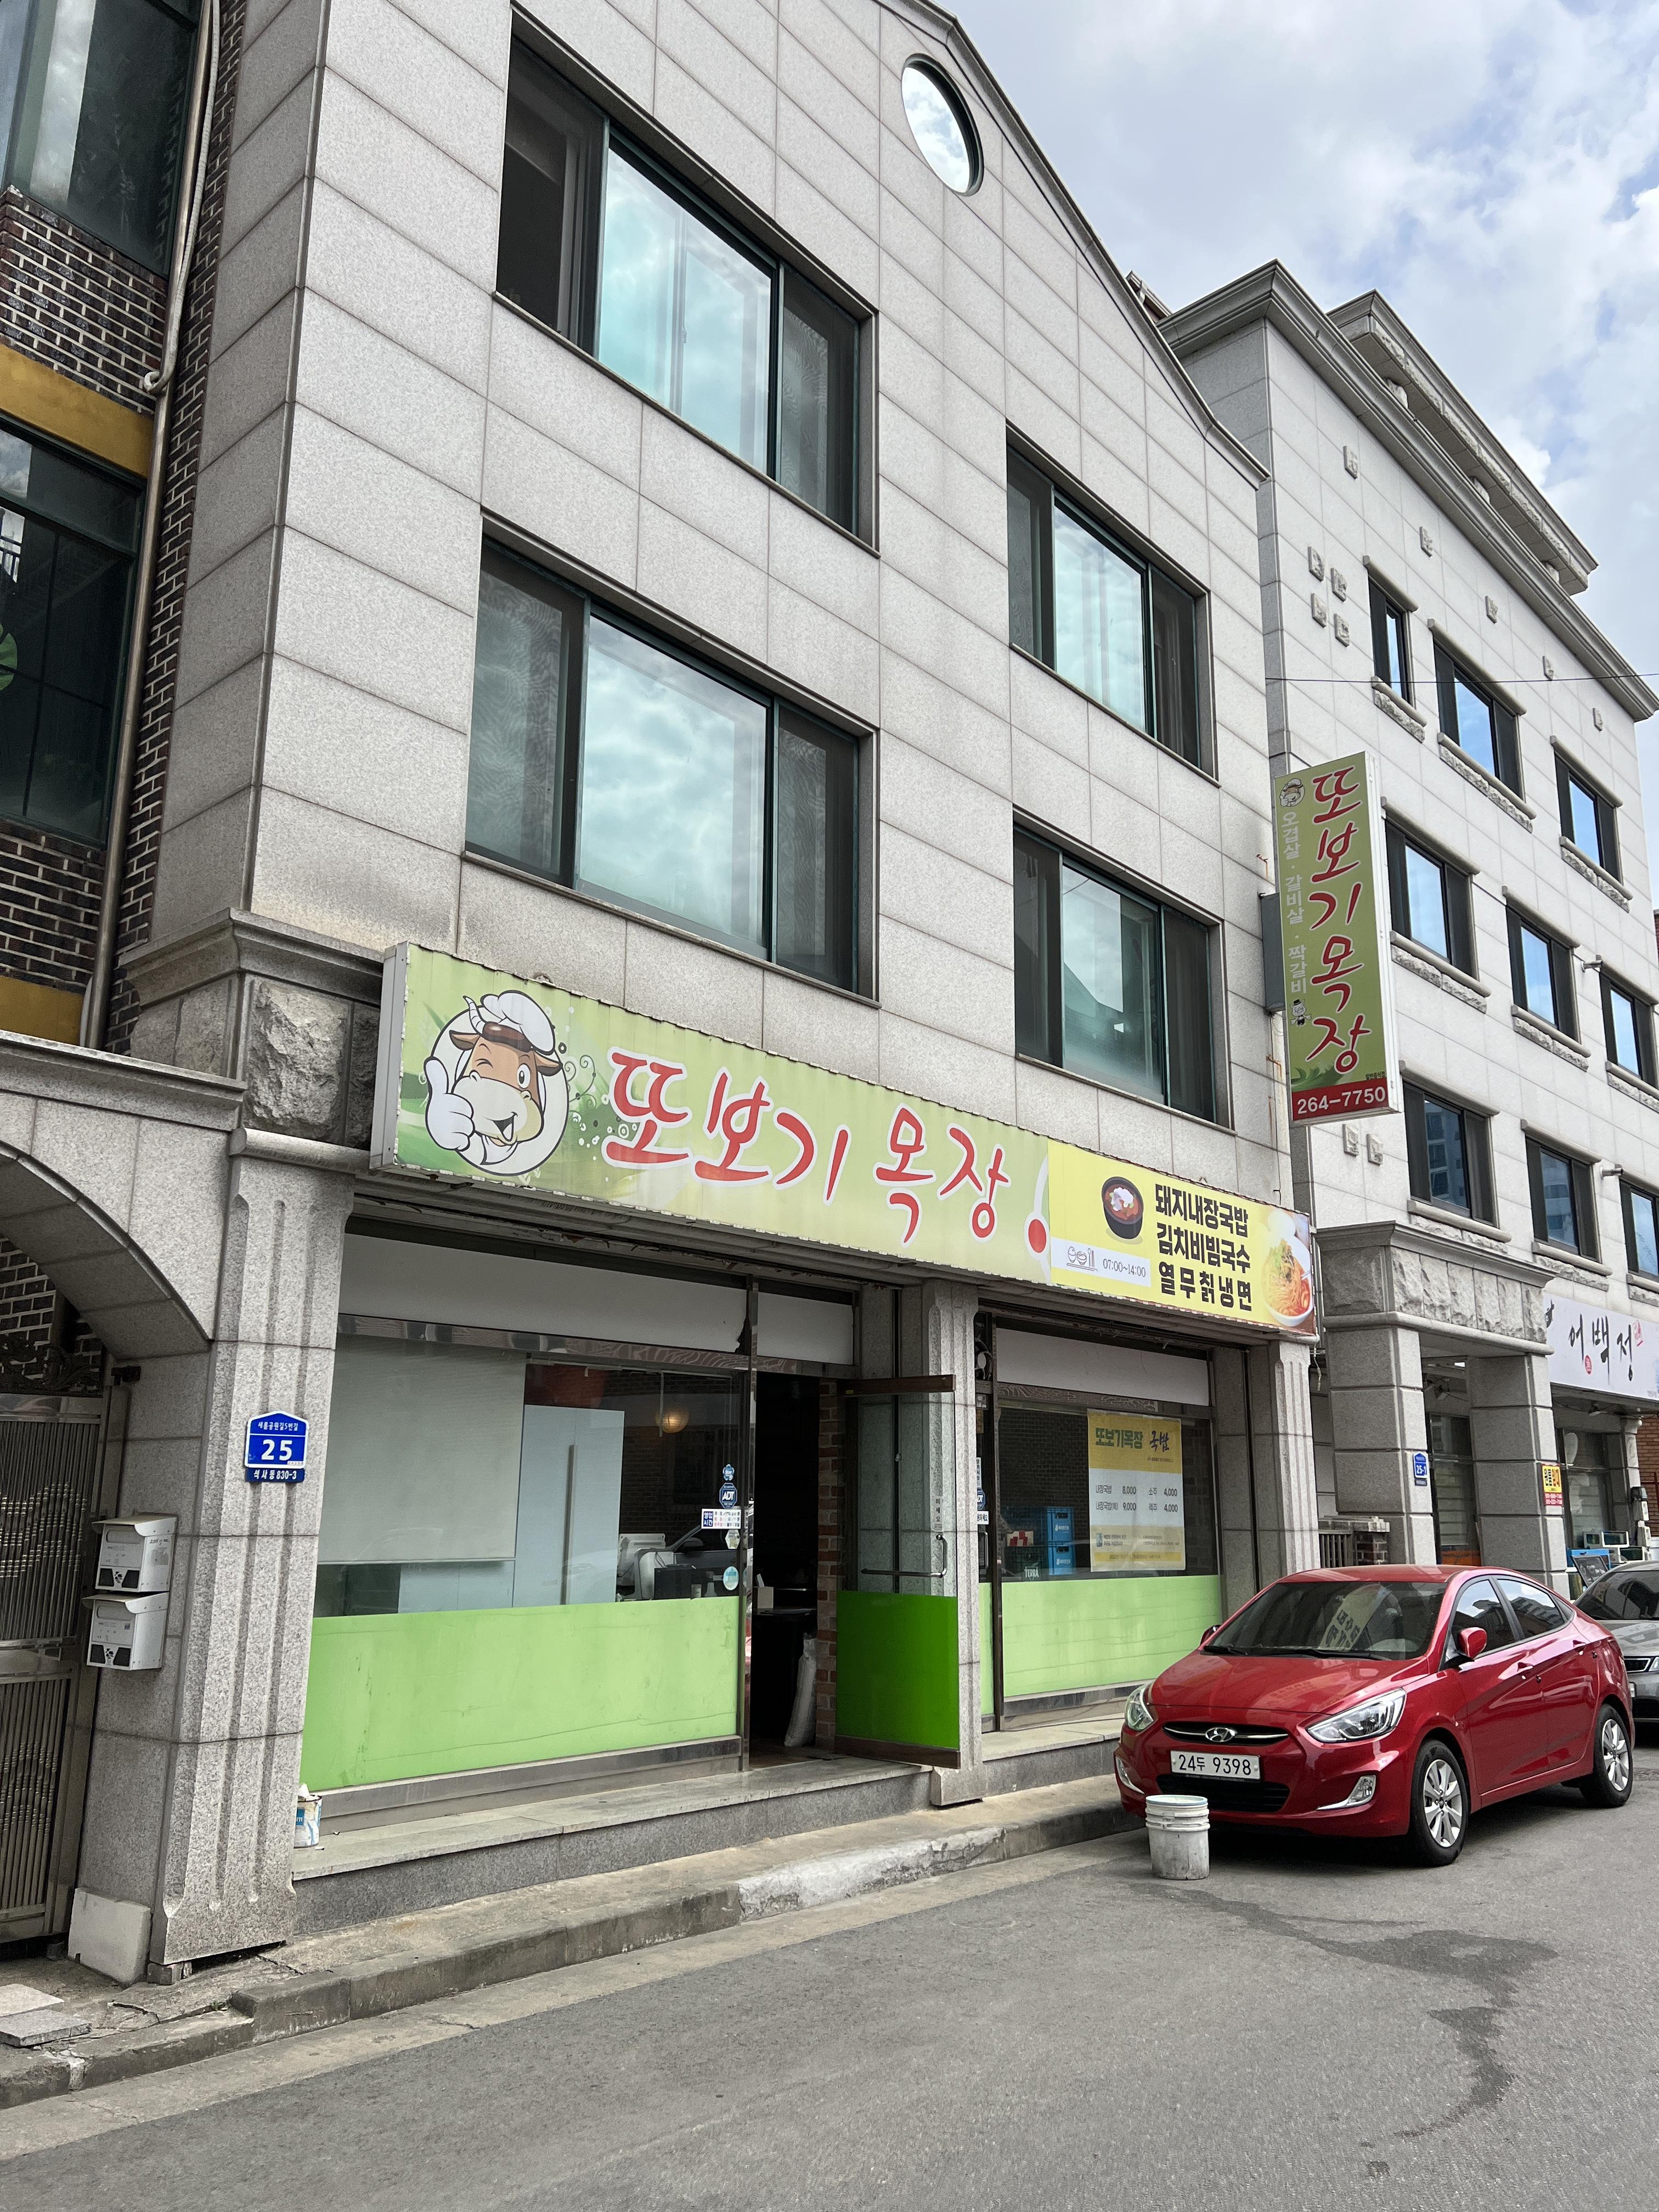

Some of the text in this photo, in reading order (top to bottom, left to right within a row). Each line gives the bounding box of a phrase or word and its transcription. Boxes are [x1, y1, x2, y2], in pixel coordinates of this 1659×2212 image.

[1281, 811, 1308, 994] 오겹살 갈비살 짝갈비
[1297, 1086, 1386, 1114] 264-7750
[605, 1049, 1010, 1244] 또보기 목장
[1155, 1183, 1248, 1238] 돼지내장국밥
[1156, 1222, 1251, 1273] 김치비빔국수
[1103, 1259, 1146, 1278] 07:00~14:00
[1095, 1427, 1170, 1452] 또보기목장 국밥
[261, 1439, 292, 1461] 25
[253, 1469, 297, 1480] 석사동 830-3
[1416, 1465, 1426, 1474] 25-1
[722, 1491, 735, 1500] ADT
[1122, 1486, 1137, 1495] 8,000
[1149, 1487, 1178, 1497] 소주 4,000
[1122, 1502, 1137, 1511] 9,000
[1164, 1504, 1178, 1513] 4,000
[1024, 1566, 1039, 1578] TERRA
[1179, 1754, 1251, 1775] 24두 9398
